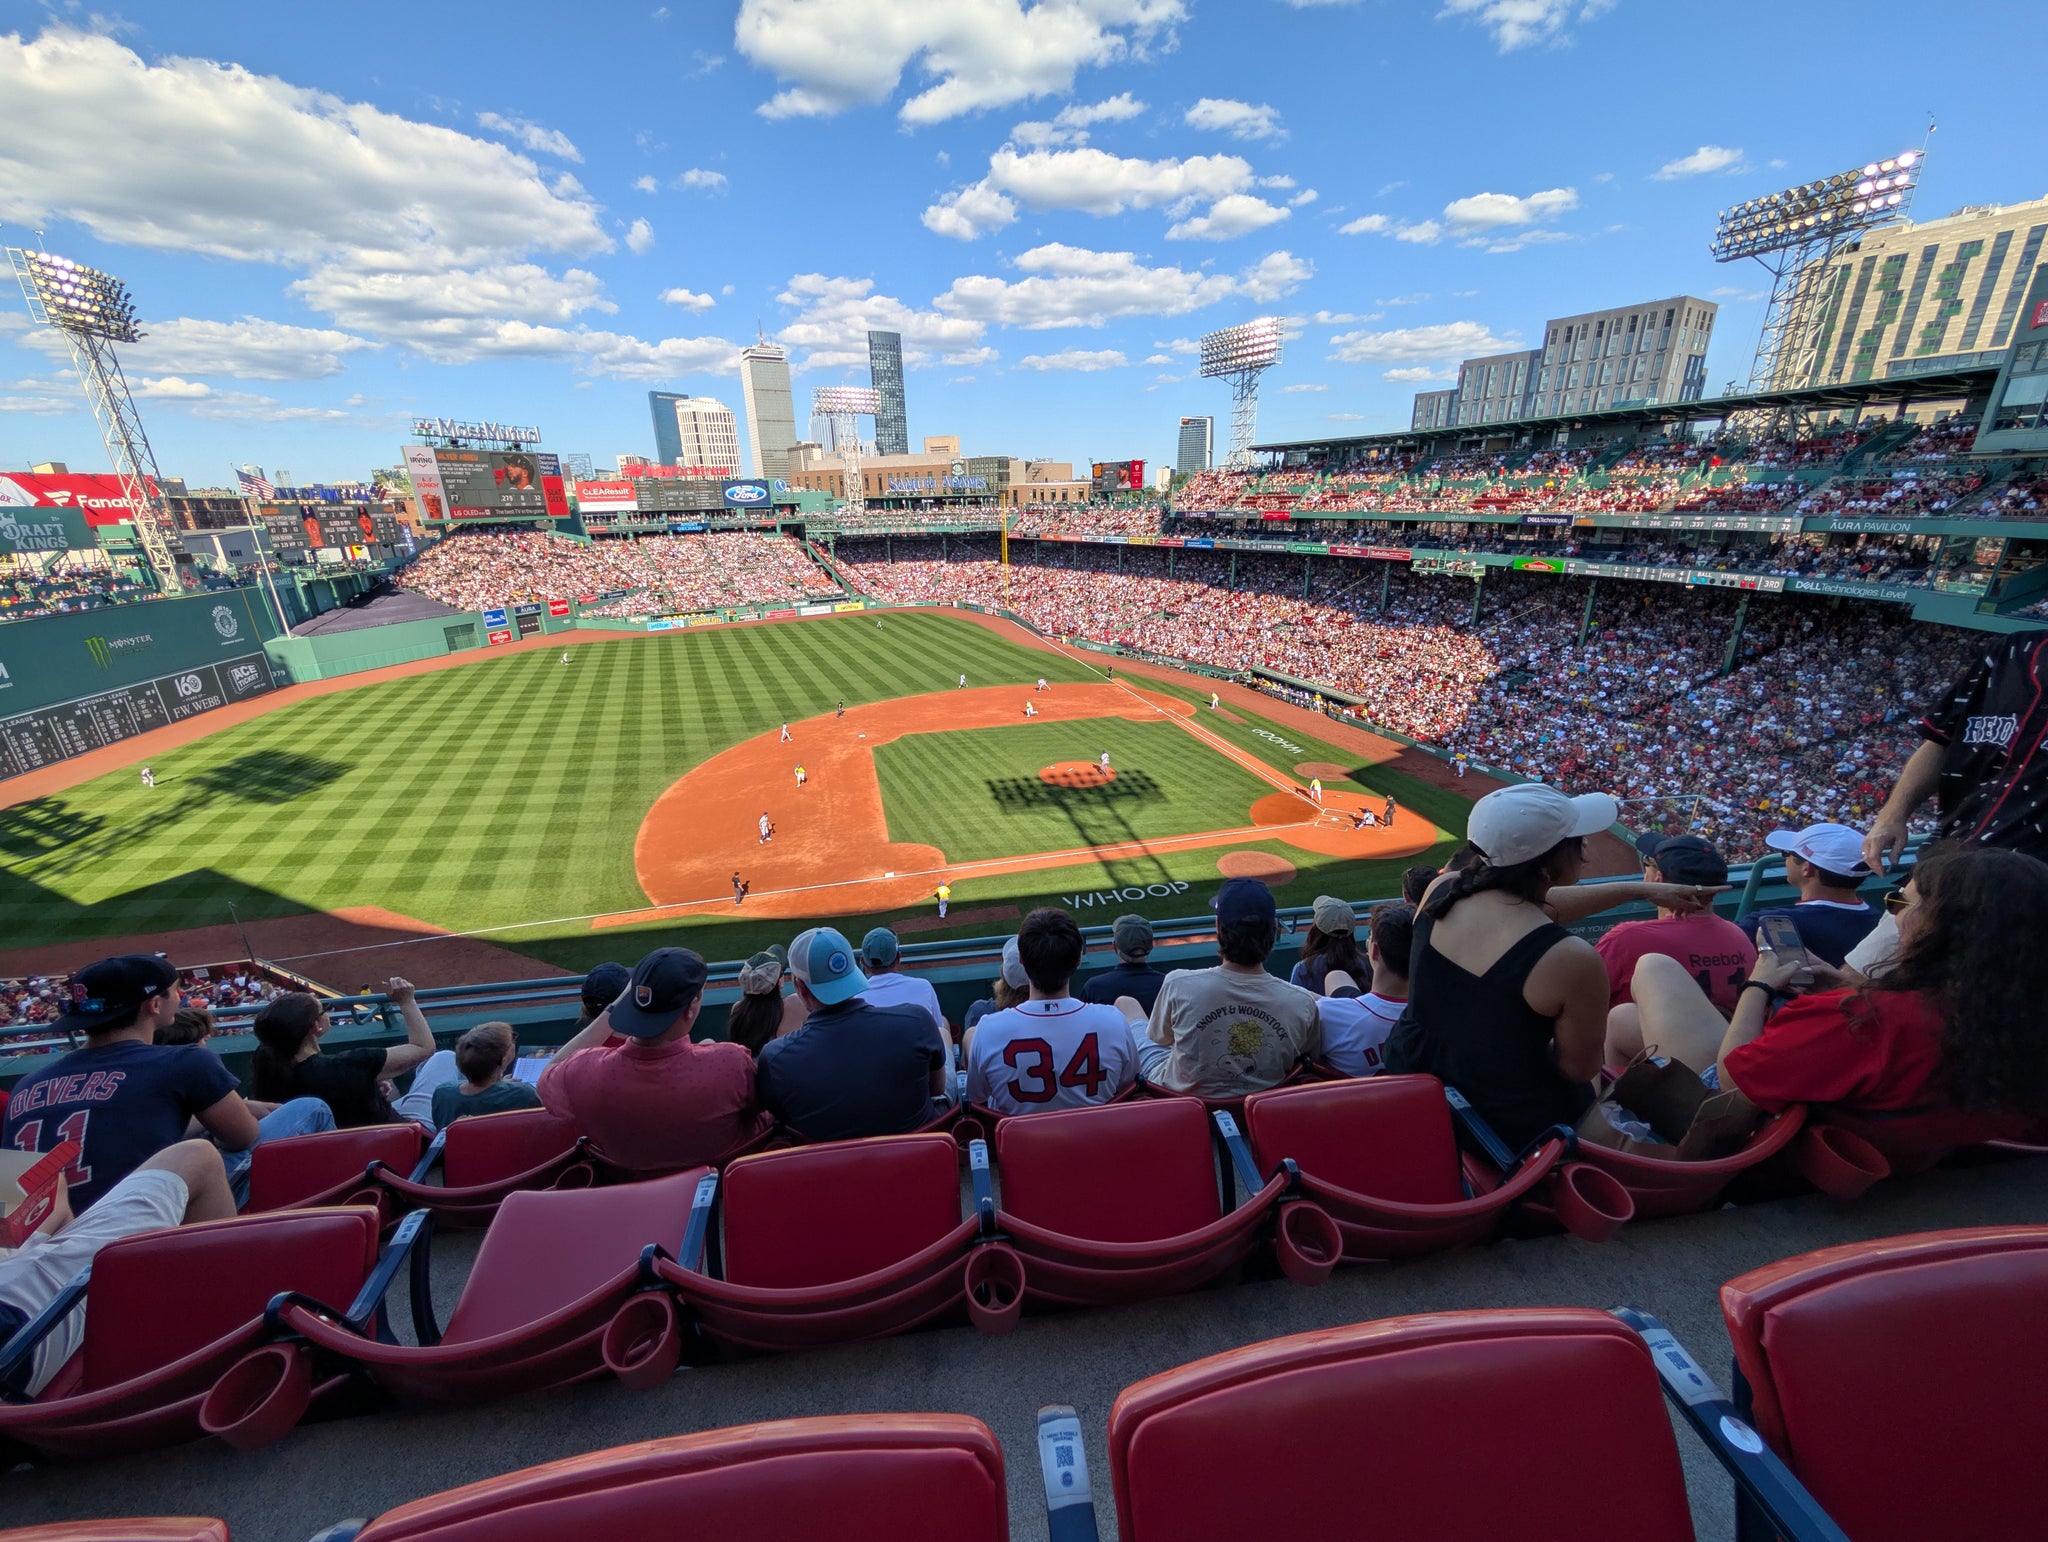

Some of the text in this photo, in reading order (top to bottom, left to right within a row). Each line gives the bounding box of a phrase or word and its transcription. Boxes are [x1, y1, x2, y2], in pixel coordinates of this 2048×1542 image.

[435, 417, 541, 443] MassMutual
[409, 456, 433, 464] IRVING
[888, 476, 986, 491] SAMUEL ADAMS
[733, 487, 759, 499] Ford
[2, 523, 65, 540] DRAFT
[1863, 522, 1911, 532] PAVILION
[15, 536, 69, 550] KINGS
[329, 533, 359, 544] 2 0 2
[1763, 580, 1780, 588] 3RD
[1795, 580, 1908, 600] DELL Technologies Level
[108, 634, 153, 649] MONSTER
[233, 664, 258, 679] ACE
[271, 669, 286, 678] 379
[174, 674, 203, 698] 160
[238, 672, 259, 688] TICKET
[77, 690, 130, 707] NATIONAL LEAGUE
[173, 695, 222, 719] F.W. WEBB
[6, 715, 35, 727] LEAGUE
[1962, 715, 2017, 746] RED
[1251, 728, 1304, 754] WHOOP
[30, 753, 42, 761] LAD
[1062, 881, 1189, 909] WHOOP
[1688, 952, 1746, 968] Reebok
[1196, 1005, 1289, 1041] SNOOPY & WOODSTOCK
[1002, 1032, 1107, 1103] 34
[10, 1071, 126, 1120] DEVERS
